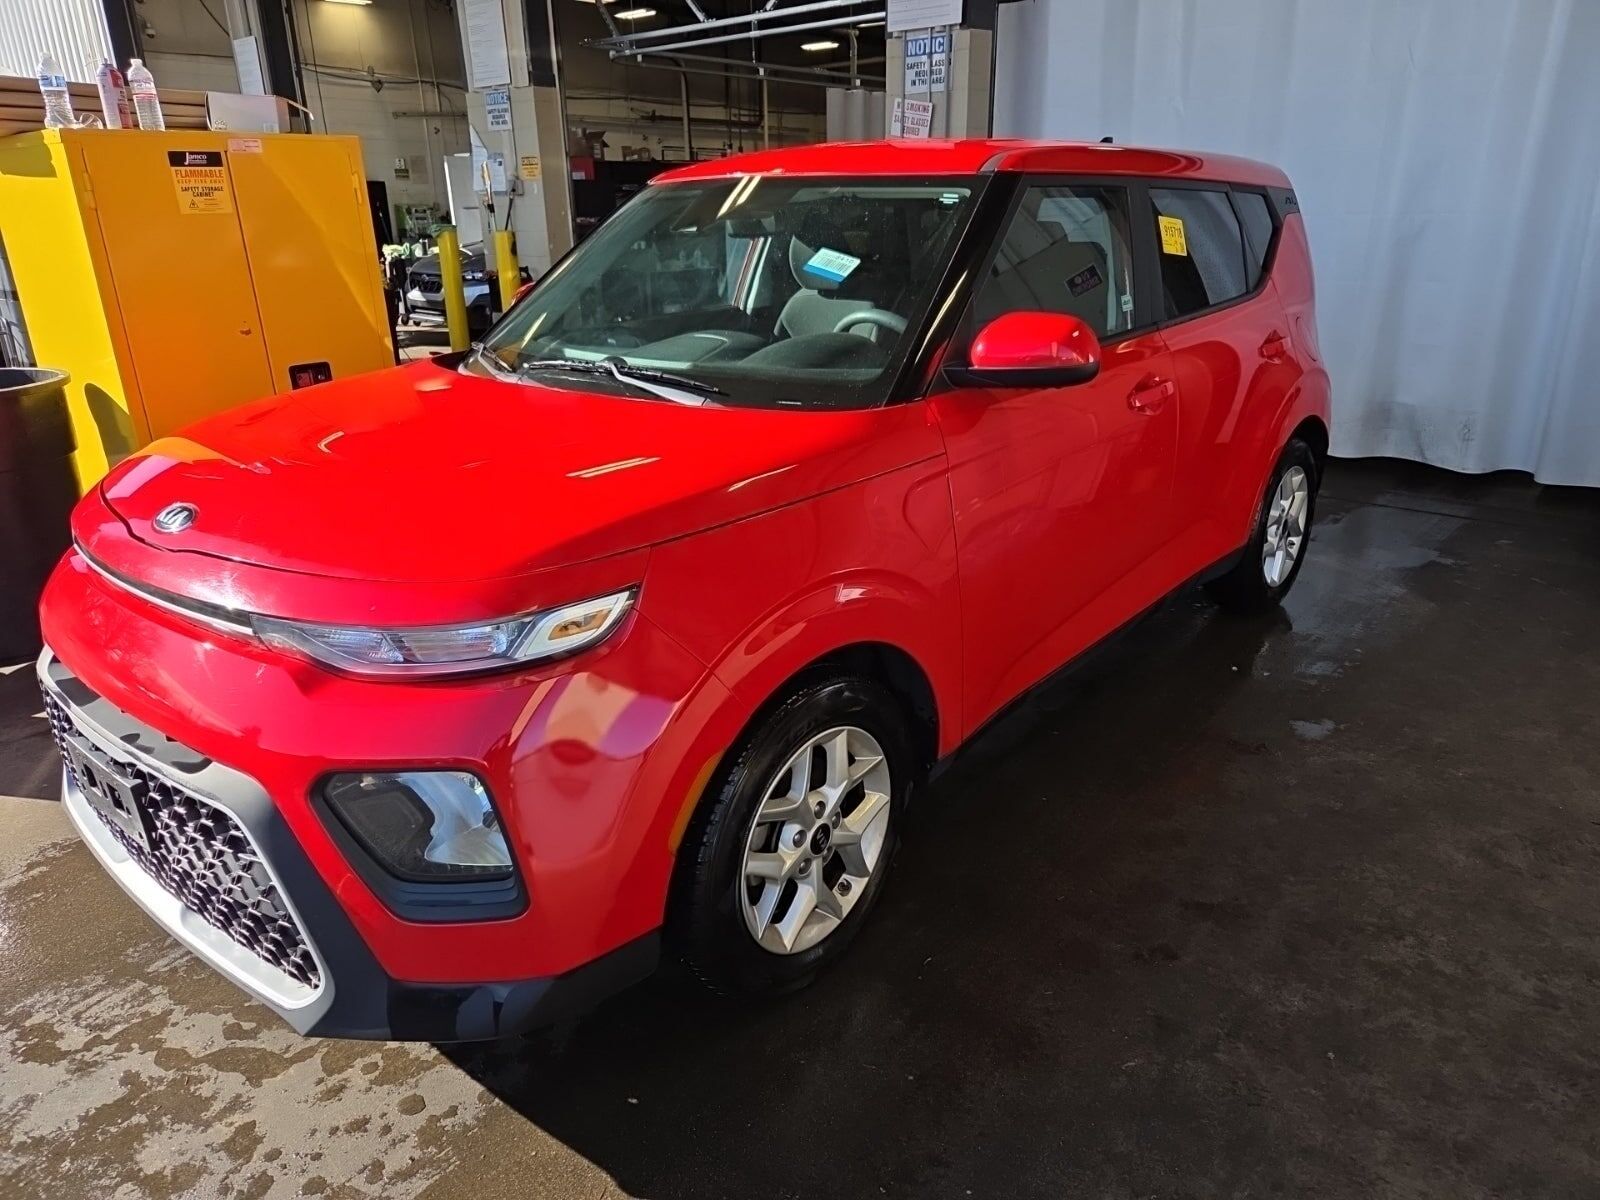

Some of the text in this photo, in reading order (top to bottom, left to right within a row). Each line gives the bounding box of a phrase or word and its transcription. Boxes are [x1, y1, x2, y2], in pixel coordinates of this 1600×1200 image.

[907, 36, 946, 56] NOTIC
[906, 61, 926, 70] SAFETY
[906, 102, 930, 113] SMOKING
[911, 117, 929, 127] GLASSES
[184, 152, 207, 165] Jamco
[175, 169, 224, 178] FLAMMABLE
